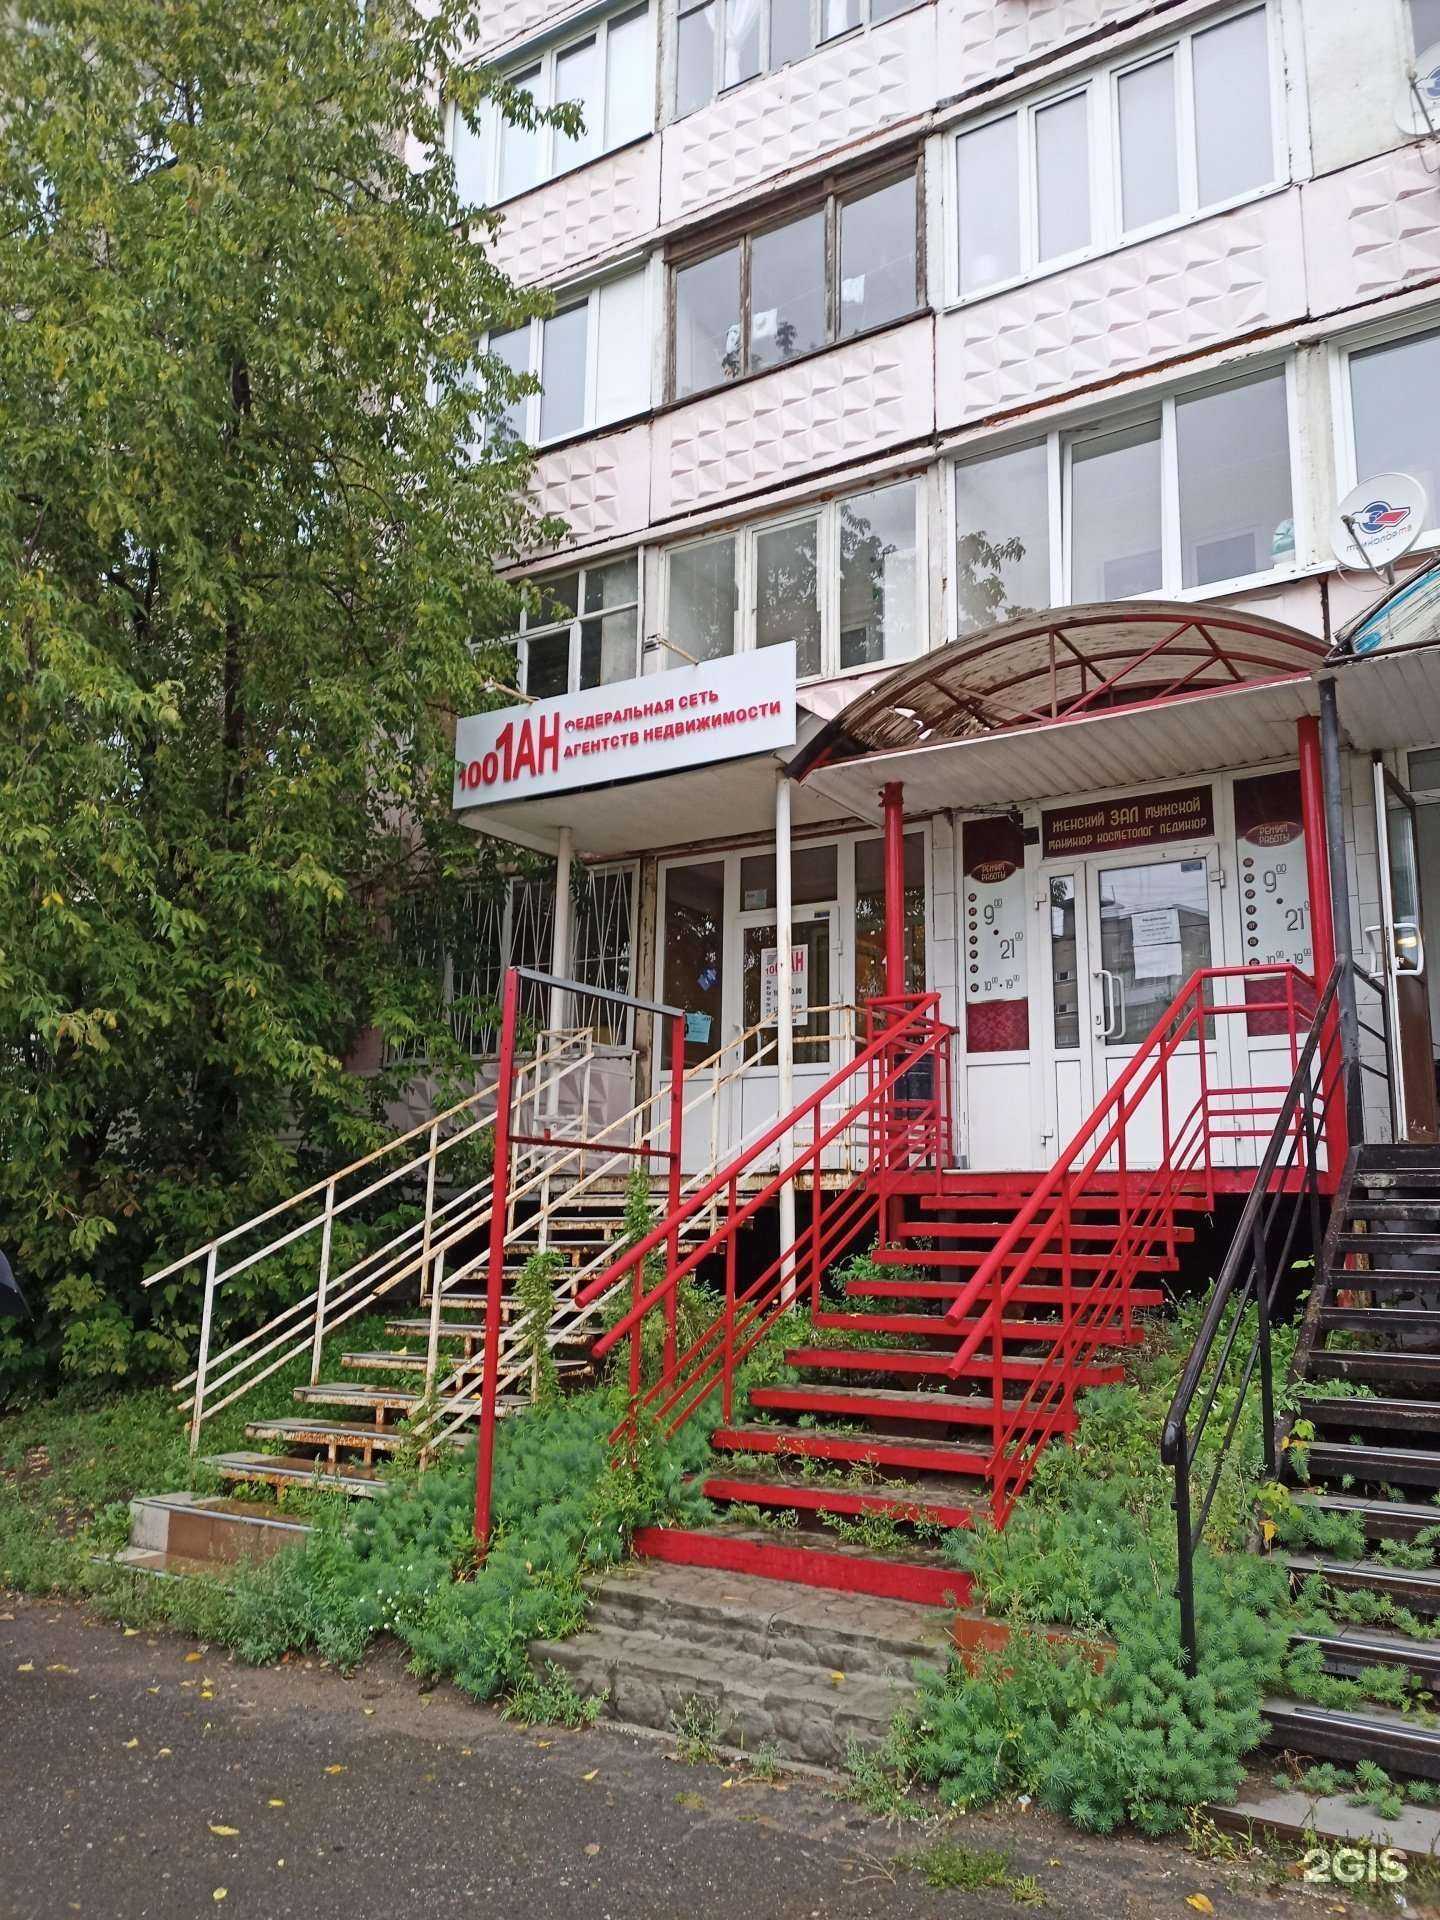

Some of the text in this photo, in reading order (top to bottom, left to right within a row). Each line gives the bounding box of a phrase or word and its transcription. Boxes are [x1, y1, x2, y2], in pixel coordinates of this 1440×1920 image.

[563, 700, 781, 759] АГЕНТСТВ НЕДВИЖИМОСТИ
[564, 689, 719, 731] ФЕДЕРАЛЬНАЯ СЕТЬ
[1048, 817, 1208, 850] МАНИКЮР КОСМЕТОЛОГ ПЕДИКЮР
[1052, 797, 1201, 833] ЖЕНСКИЙ ЗАЛ МУЖСКОЙ
